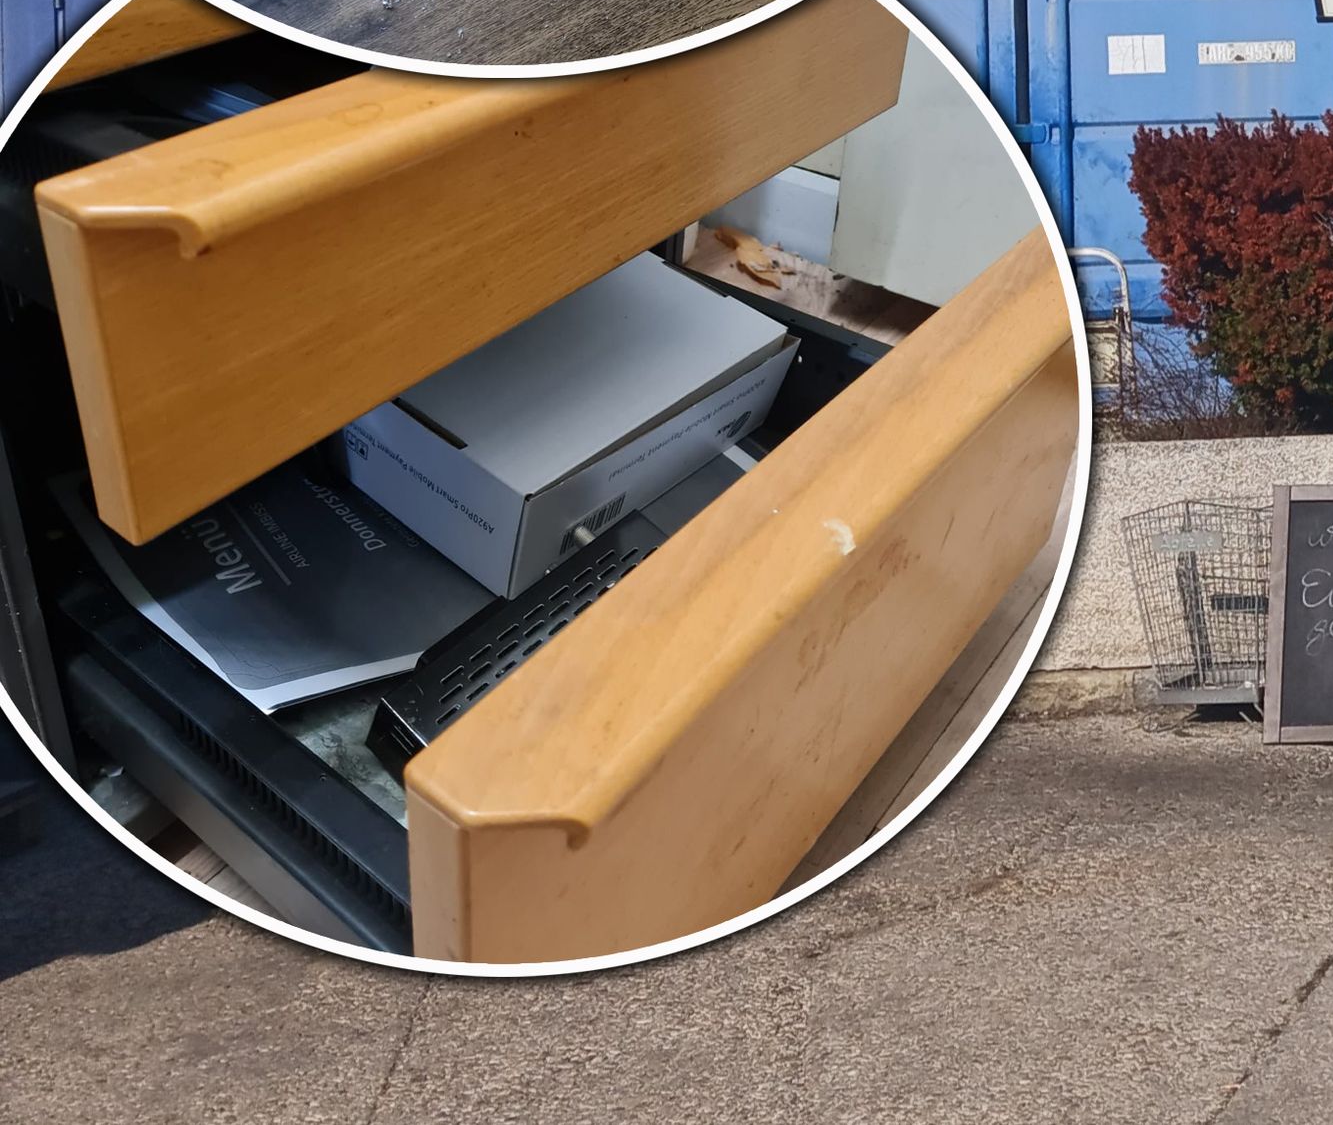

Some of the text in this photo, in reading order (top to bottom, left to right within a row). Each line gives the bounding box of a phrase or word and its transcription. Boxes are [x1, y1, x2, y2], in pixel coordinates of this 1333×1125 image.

[377, 440, 408, 470] Payment
[409, 465, 435, 491] Mobile
[436, 485, 459, 509] Smart
[460, 504, 495, 534] A920Pro
[251, 502, 310, 569] AIRLINE IMBISS
[181, 518, 263, 595] Menü
